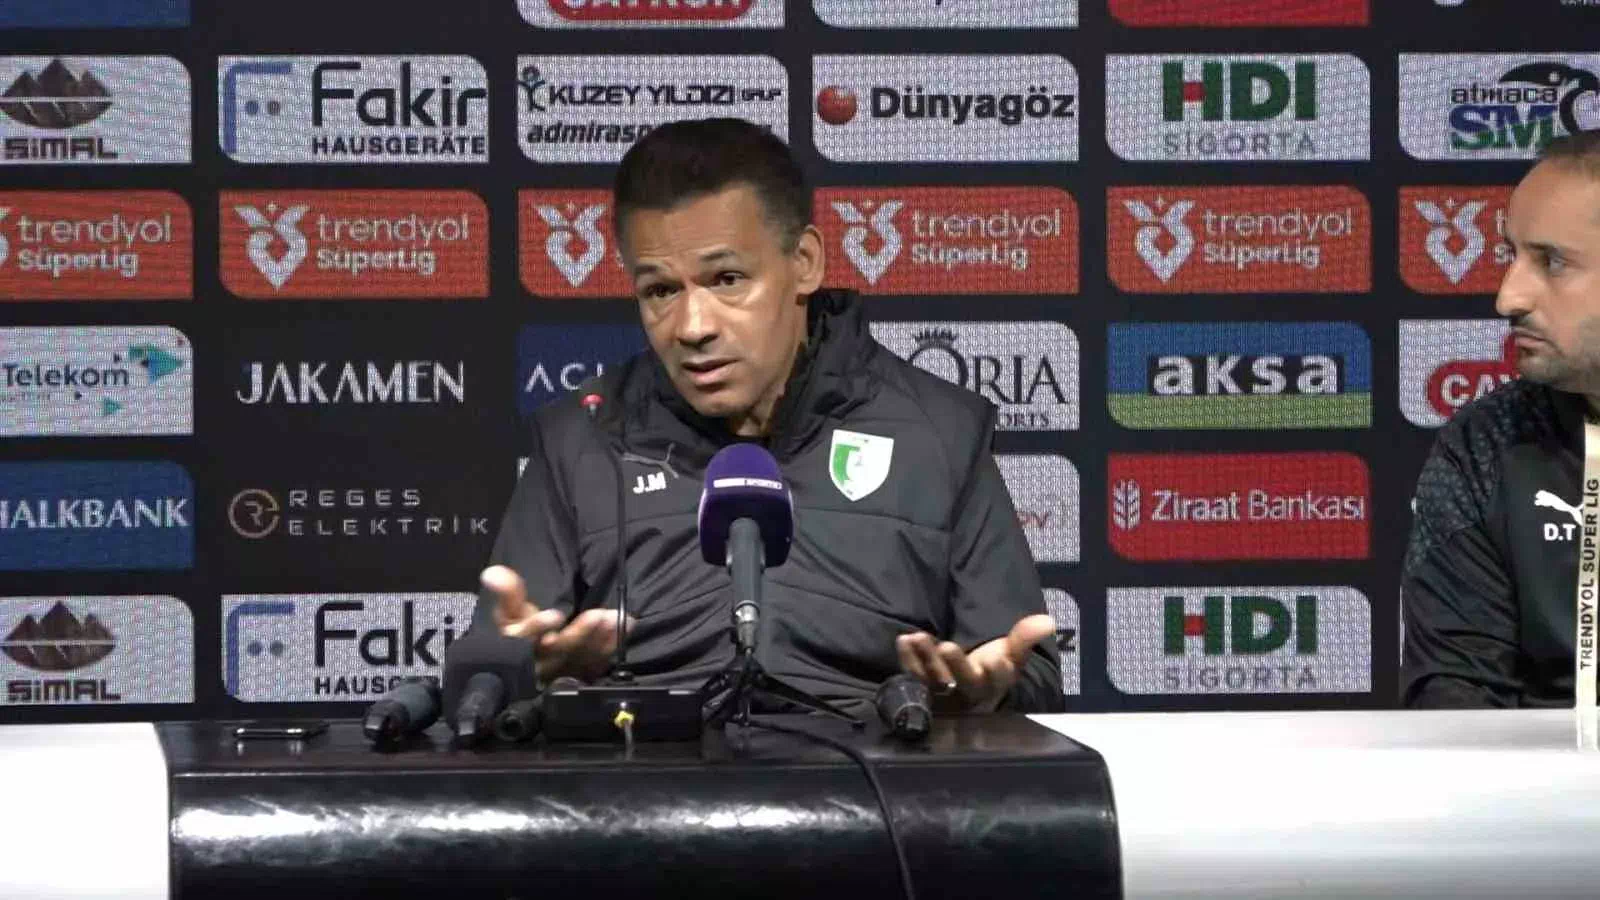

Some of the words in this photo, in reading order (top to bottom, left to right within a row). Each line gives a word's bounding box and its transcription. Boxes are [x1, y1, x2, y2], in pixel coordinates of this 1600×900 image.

[312, 61, 487, 127] Fakir
[549, 86, 640, 105] KUZEY
[648, 86, 735, 105] YILDIZI
[871, 85, 1075, 125] Dünyagöz
[1163, 61, 1316, 121] HDI
[1451, 83, 1559, 103] atmaca
[313, 130, 486, 155] HAUSGERÄTE
[17, 214, 172, 248] trendyol
[317, 214, 468, 247] trendyol
[912, 209, 1061, 240] trendyol
[1204, 209, 1351, 240] trendyol
[18, 249, 139, 278] SüperLig
[317, 249, 436, 275] SüperLig
[911, 244, 1028, 270] SüperLig
[1204, 242, 1321, 269] SüperLig
[2, 361, 129, 387] Telekom
[237, 361, 465, 404] JAKAMEN
[1153, 356, 1339, 396] aksa
[289, 489, 420, 507] REGES
[633, 471, 667, 494] J.M
[1152, 490, 1240, 521] Ziraat
[1248, 489, 1365, 521] Bankası
[289, 515, 489, 535] ELEKTRİK
[1544, 523, 1577, 541] D.T
[1583, 513, 1597, 573] SUPER
[1164, 596, 1318, 655] HDI
[1580, 578, 1595, 671] TRENDYOL
